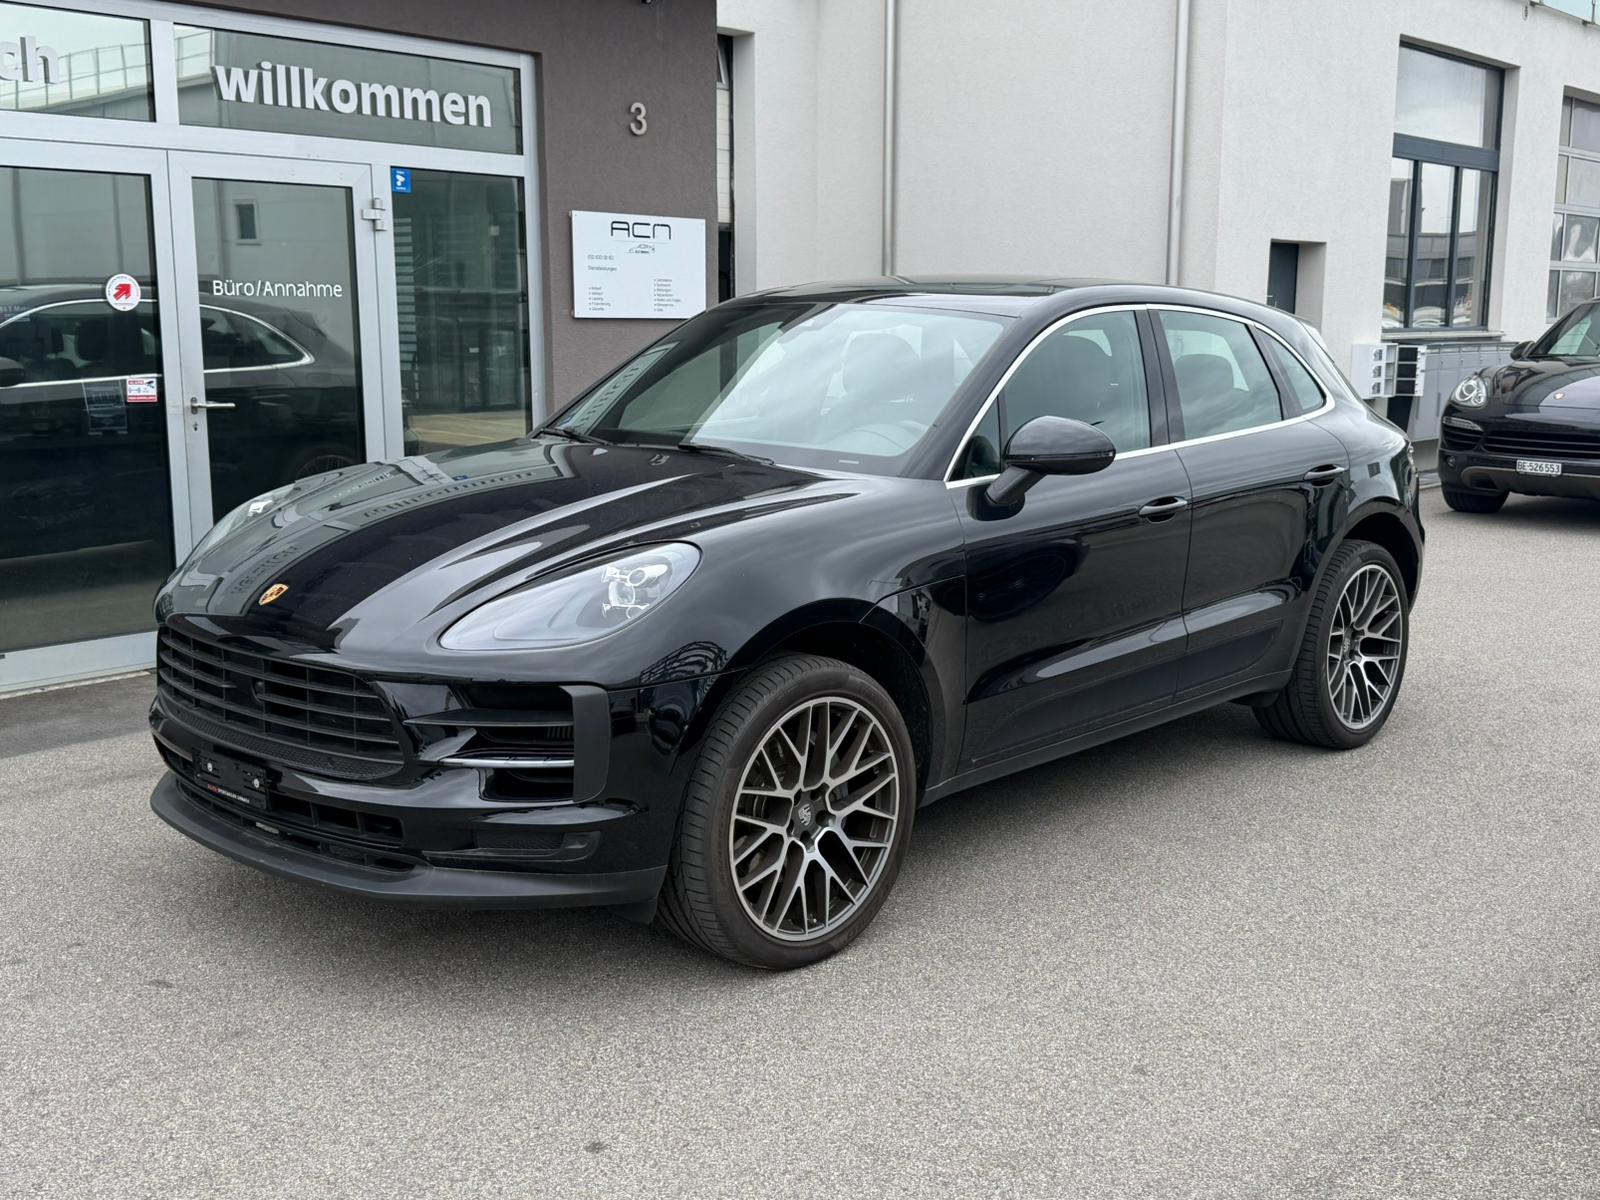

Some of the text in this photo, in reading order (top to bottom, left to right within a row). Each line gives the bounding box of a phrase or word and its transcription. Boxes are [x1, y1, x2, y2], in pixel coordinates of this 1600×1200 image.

[213, 61, 492, 128] willkommen
[629, 102, 648, 136] 3
[610, 220, 672, 241] ACN
[212, 279, 343, 298] Büro/Annahme
